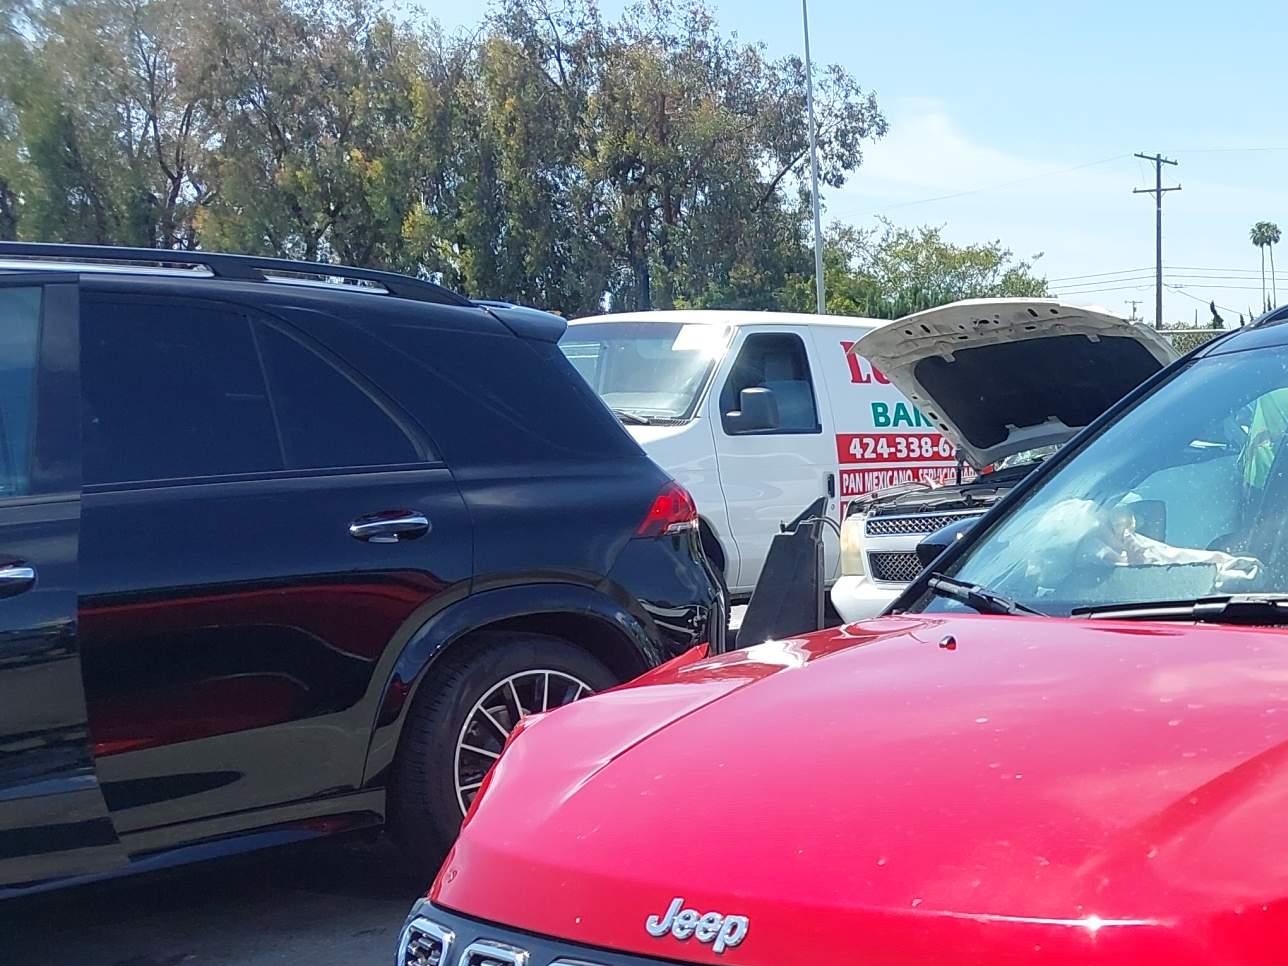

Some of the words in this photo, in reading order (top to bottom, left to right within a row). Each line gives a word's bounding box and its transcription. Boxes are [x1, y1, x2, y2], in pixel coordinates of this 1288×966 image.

[842, 473, 863, 494] PAN
[864, 469, 912, 490] MEXICANO
[646, 897, 749, 954] Jeep
